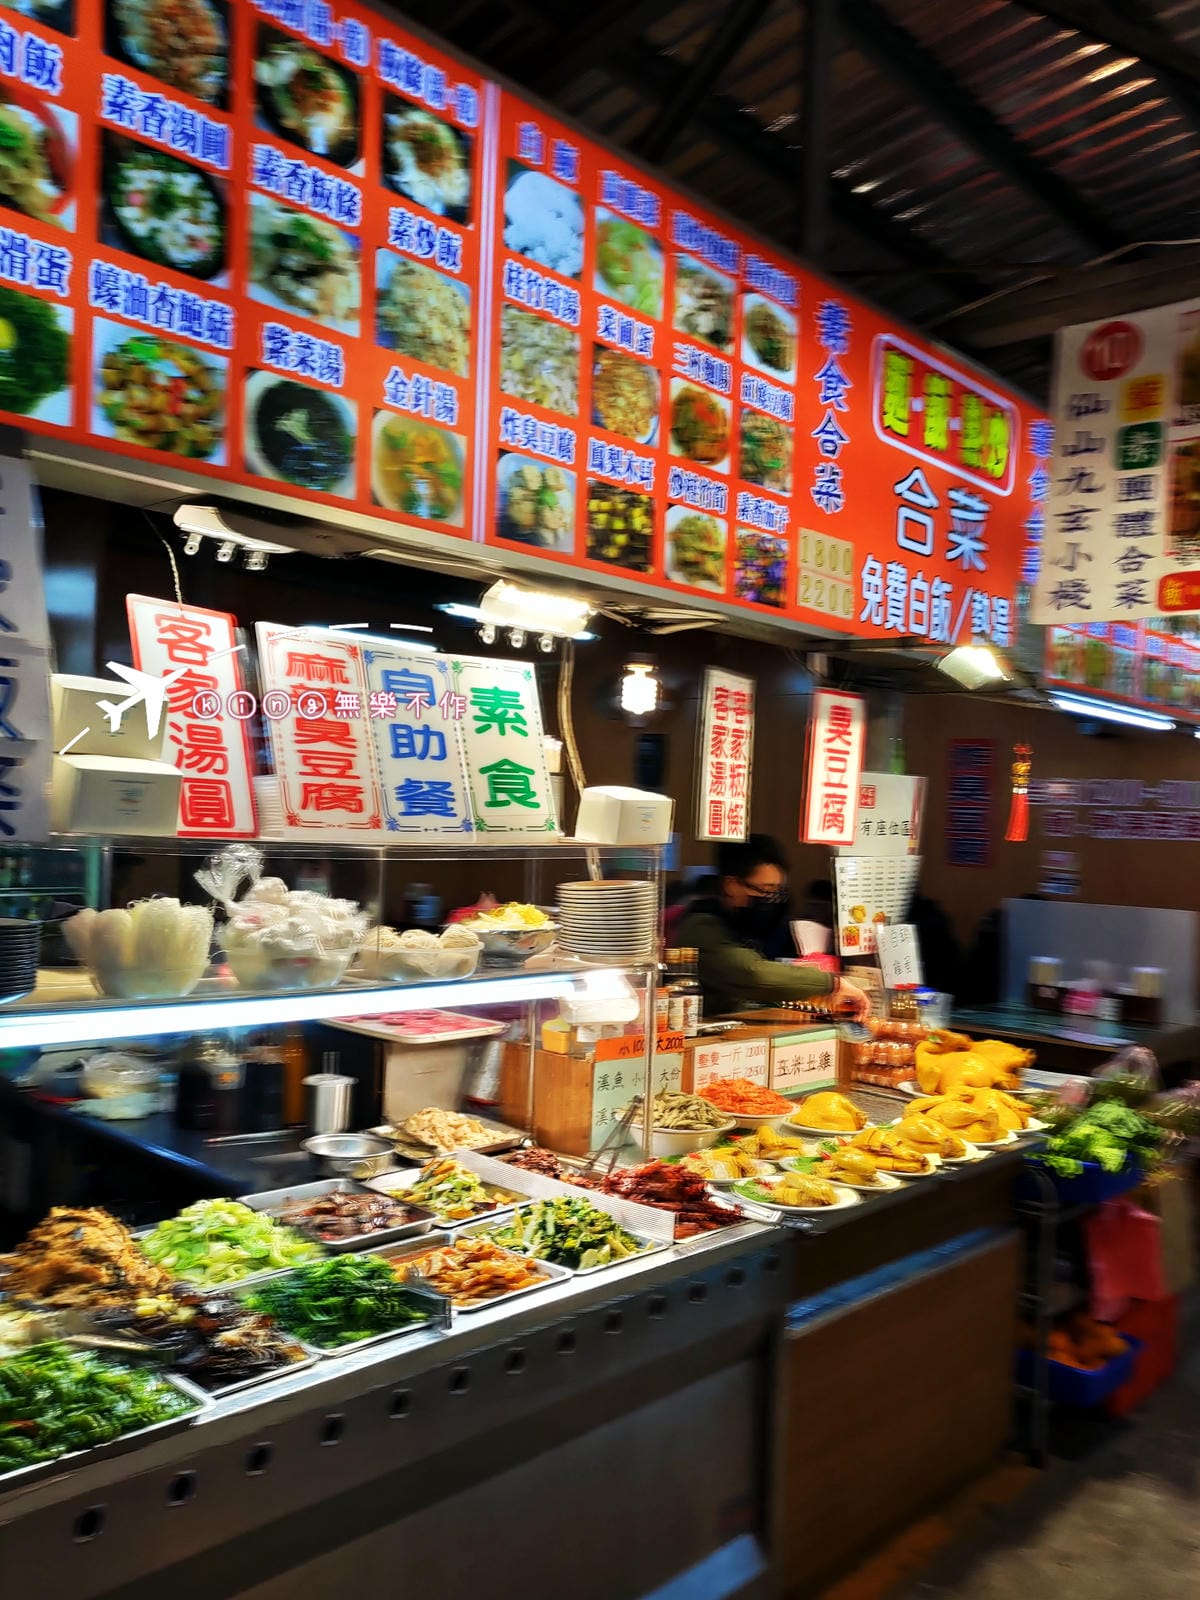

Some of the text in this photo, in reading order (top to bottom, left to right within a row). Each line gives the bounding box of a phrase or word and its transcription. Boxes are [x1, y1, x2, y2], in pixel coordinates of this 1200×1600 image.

[101, 74, 233, 169] 素香湯圓
[388, 207, 462, 273] 素炒飯
[90, 259, 234, 348] 蠔油杏鮑菇
[263, 323, 344, 387] 紫菜湯
[384, 366, 457, 425] 金針湯
[501, 407, 575, 463] 炸臭豆腐
[587, 438, 655, 490] 鳳梨木耳
[894, 468, 992, 572] 合菜
[155, 614, 235, 828] 客家湯圓
[380, 668, 458, 818] 自助餐
[469, 687, 541, 810] 素食
[818, 704, 853, 835] 臭豆腐
